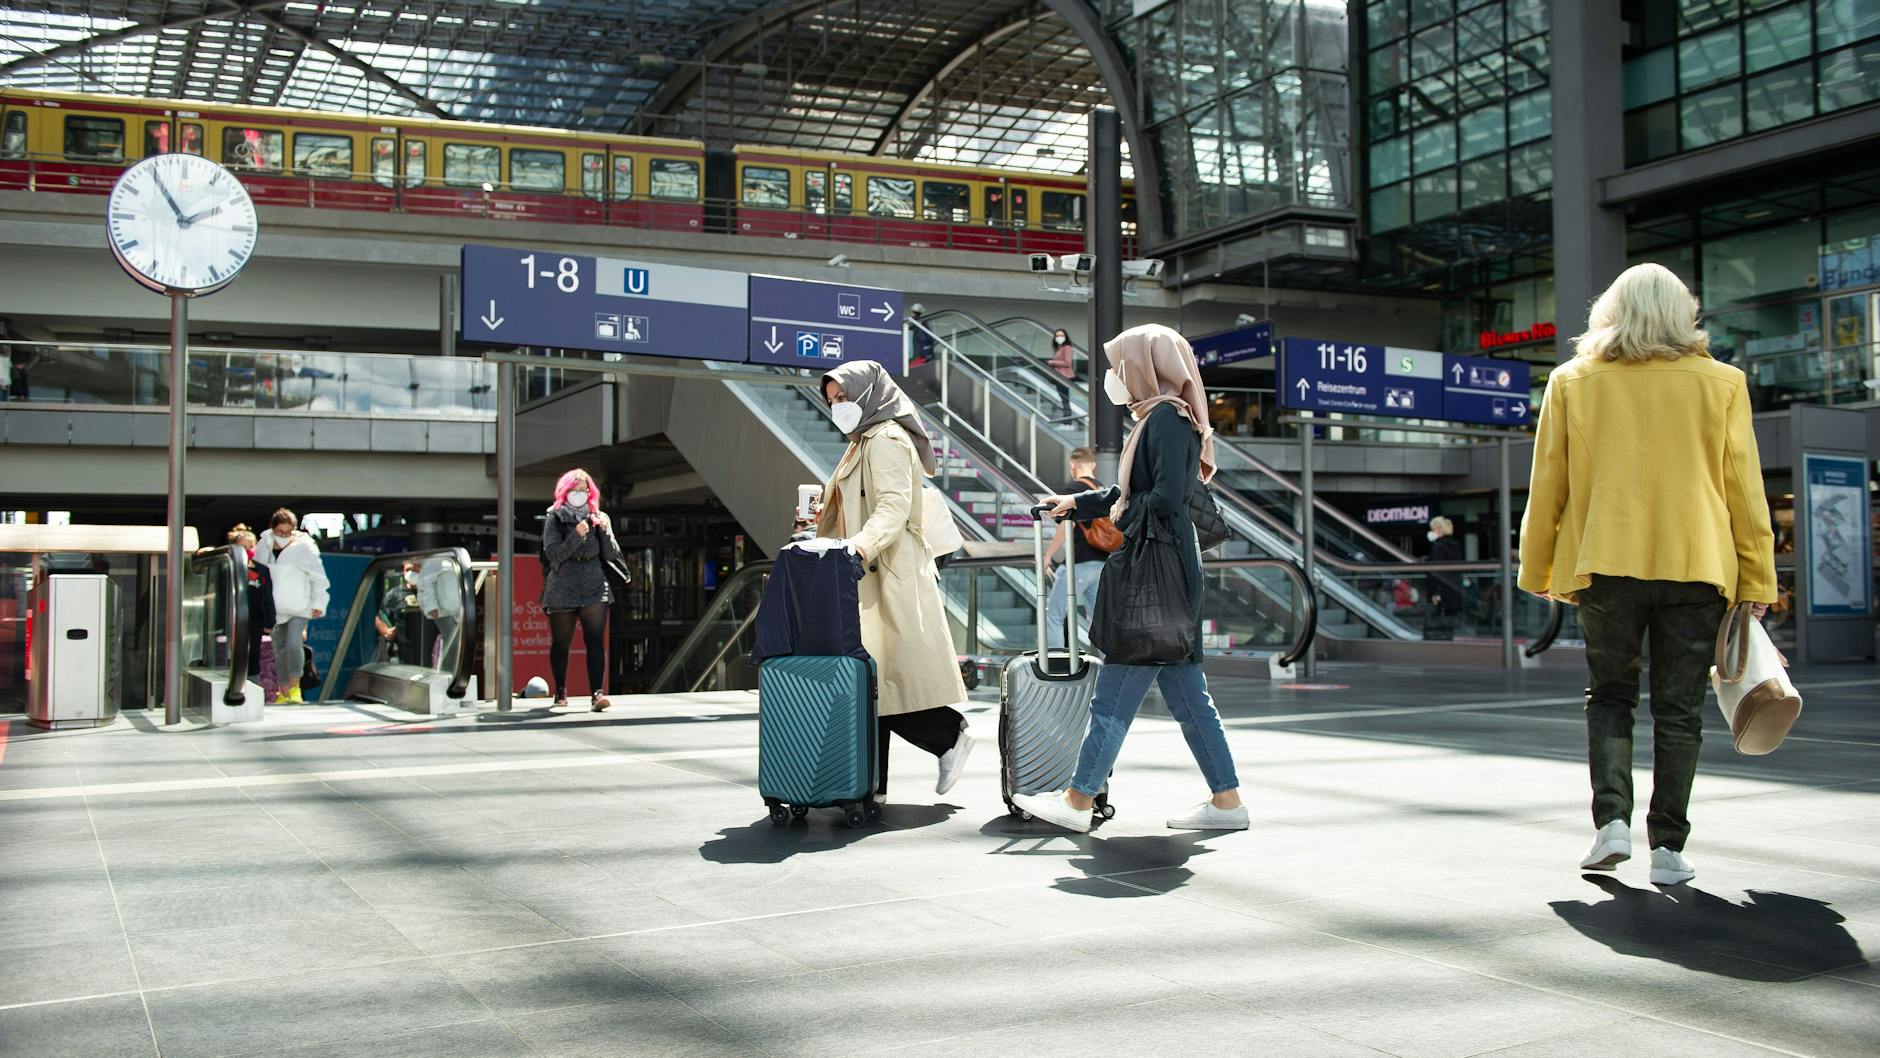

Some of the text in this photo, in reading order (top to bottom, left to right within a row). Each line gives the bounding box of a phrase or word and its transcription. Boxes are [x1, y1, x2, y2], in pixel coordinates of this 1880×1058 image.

[520, 254, 579, 293] 1-8
[628, 271, 643, 293] U
[839, 304, 856, 317] WC
[802, 340, 813, 355] P
[1317, 343, 1367, 374] 11-16
[1317, 381, 1366, 395] Reisezentrum
[1367, 505, 1429, 522] DECATHLON
[523, 617, 547, 630] dass
